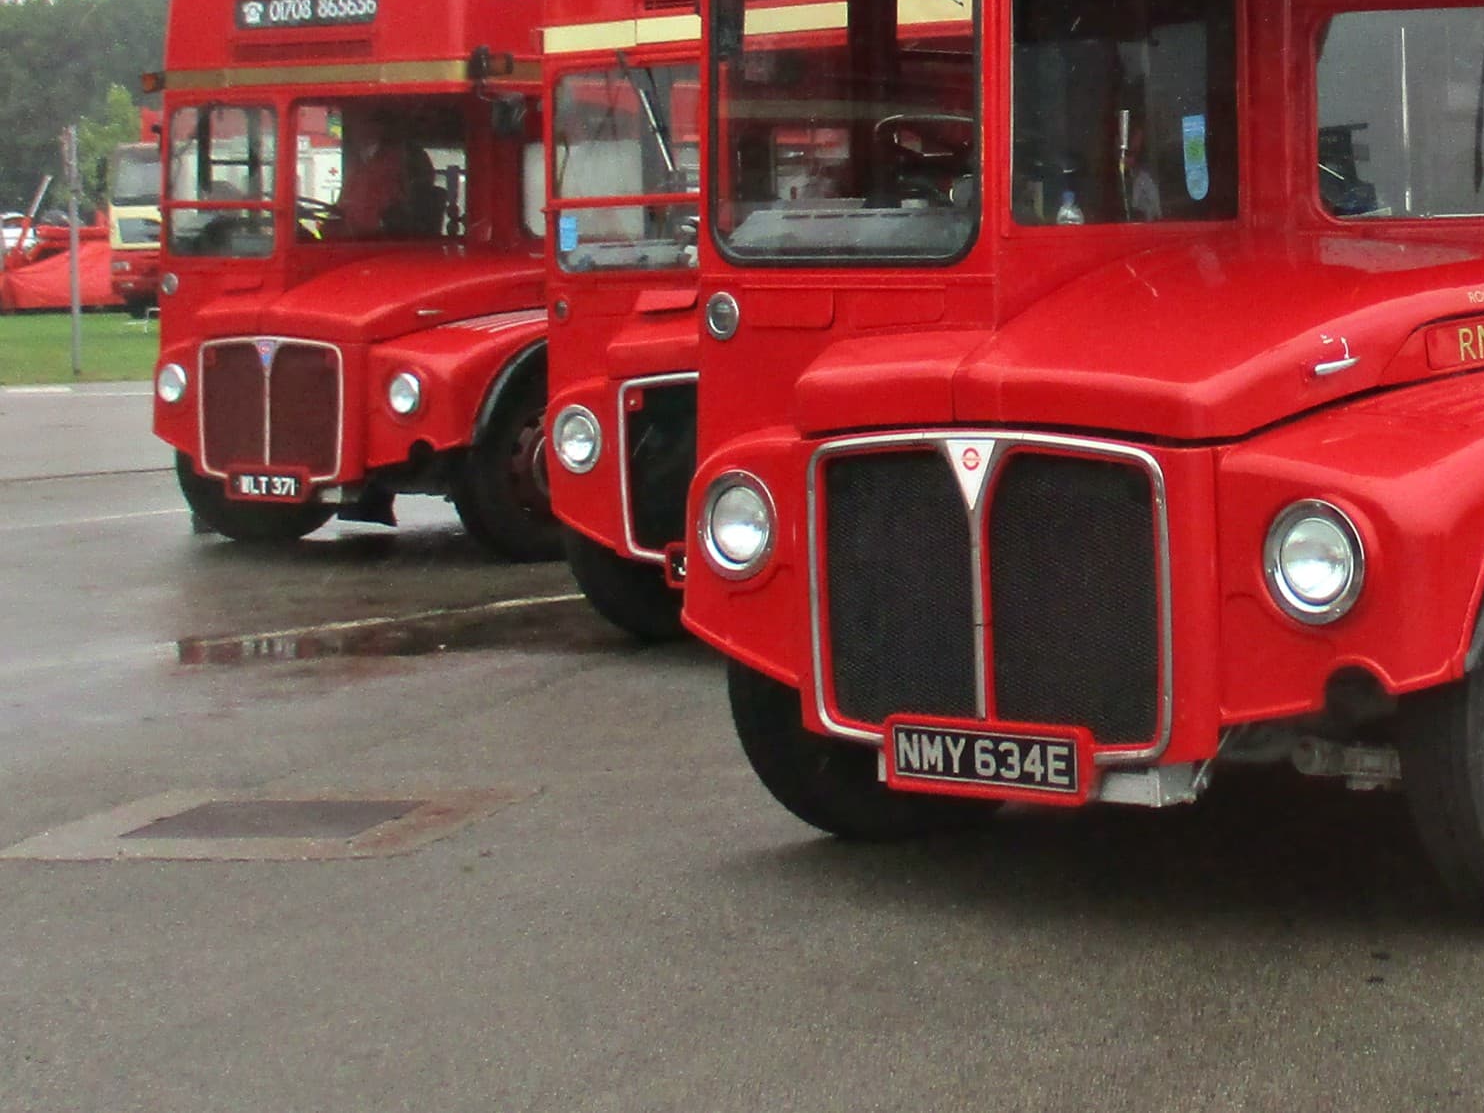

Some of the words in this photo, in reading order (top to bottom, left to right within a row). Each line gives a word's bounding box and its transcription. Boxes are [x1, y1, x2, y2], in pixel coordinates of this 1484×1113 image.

[272, 477, 295, 496] 371
[897, 731, 967, 775] NMY
[973, 738, 1071, 785] 634E
